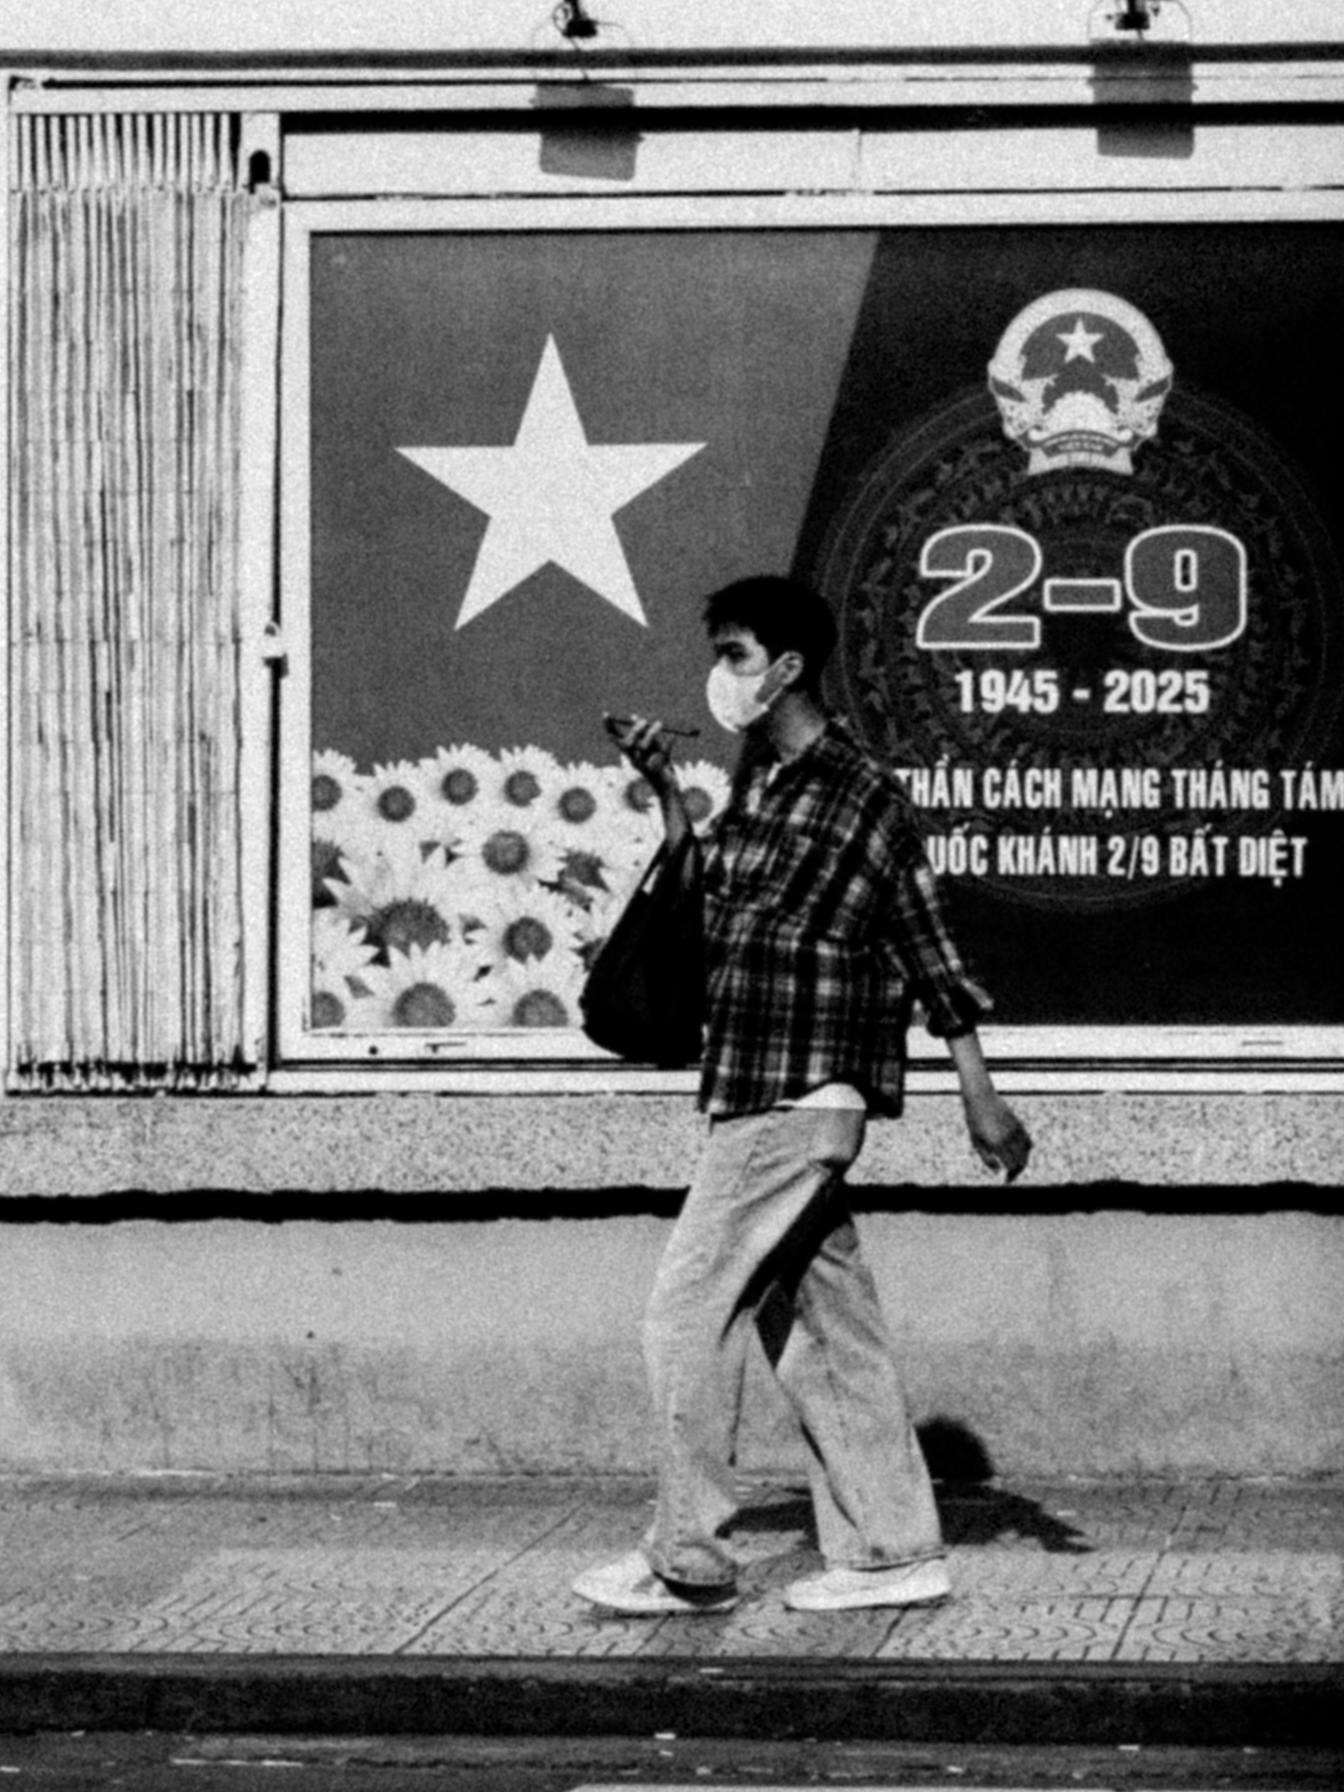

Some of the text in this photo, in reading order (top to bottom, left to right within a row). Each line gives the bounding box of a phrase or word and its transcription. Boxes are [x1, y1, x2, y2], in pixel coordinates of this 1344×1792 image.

[915, 523, 1248, 652] 2-9
[954, 668, 1211, 714] 1945 - 2025
[982, 759, 1063, 810] CÁCH
[1071, 768, 1161, 820] MẠNG
[1170, 758, 1271, 810] THÁNG
[926, 821, 1309, 888] UỐC KHÁNH 2/9 BẤT DIỆT
